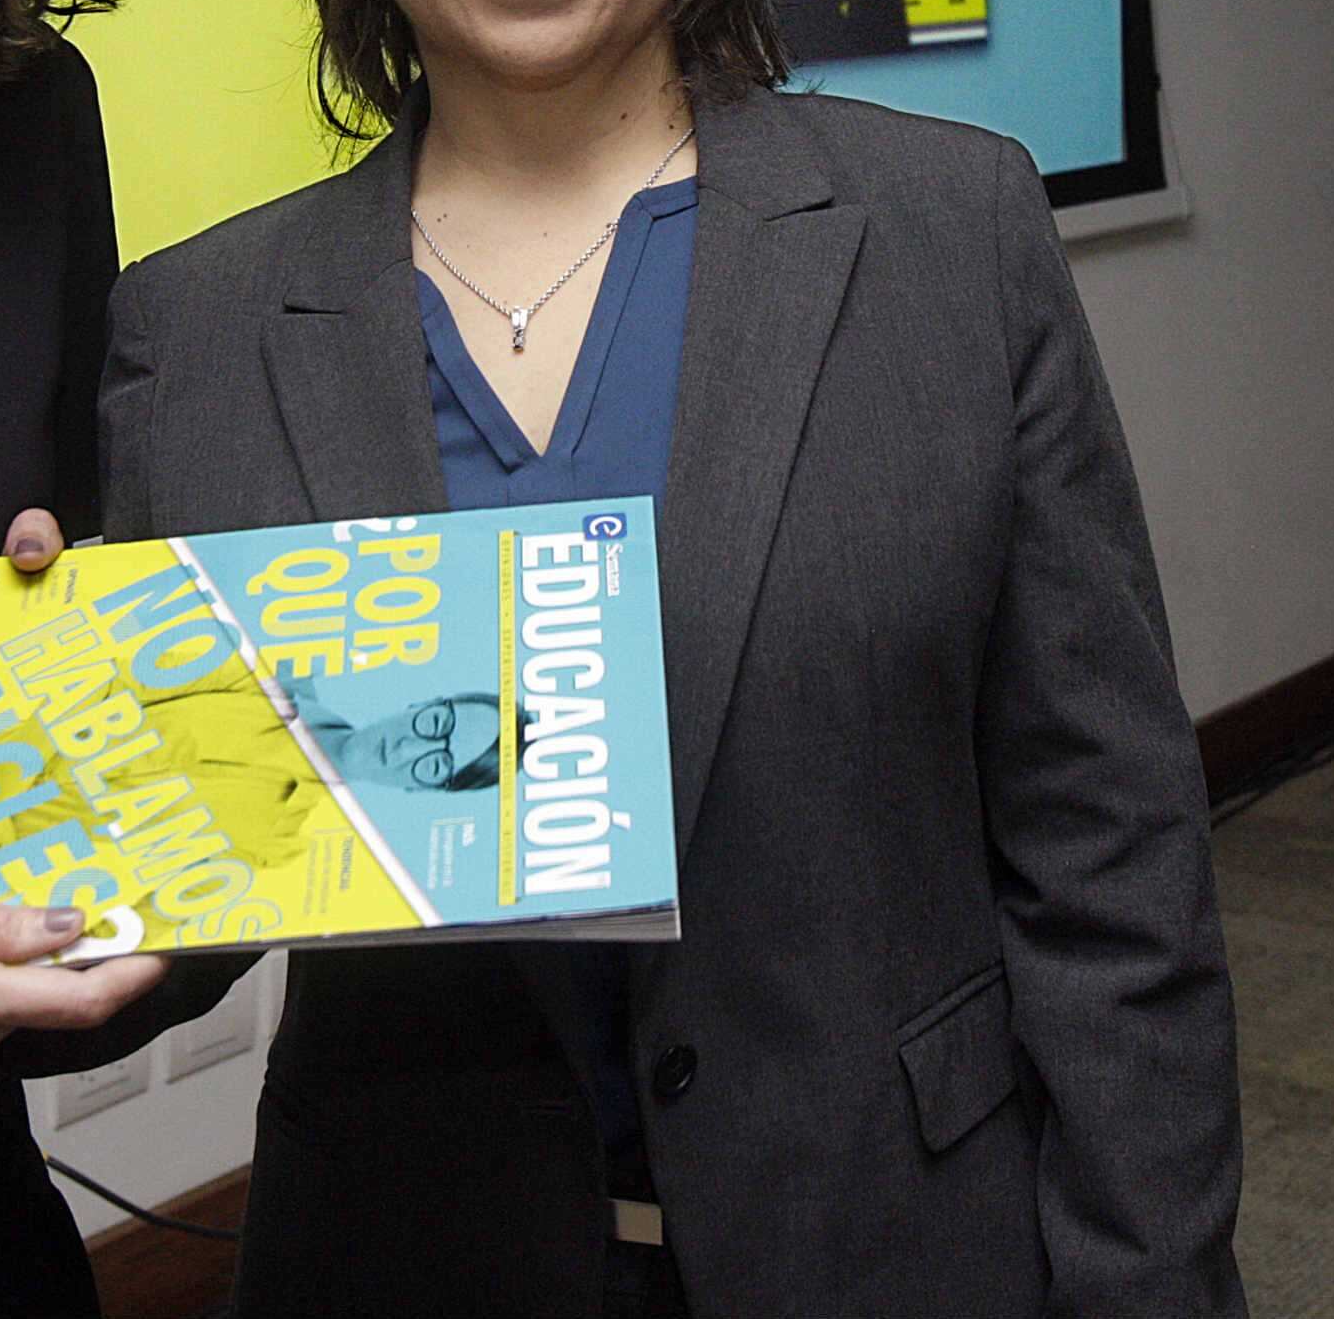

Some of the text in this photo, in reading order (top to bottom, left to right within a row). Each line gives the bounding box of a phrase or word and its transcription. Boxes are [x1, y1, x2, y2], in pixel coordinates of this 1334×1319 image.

[93, 563, 244, 690] NO
[332, 518, 442, 673] ¿POR
[522, 532, 632, 896] EDUCACIÓN
